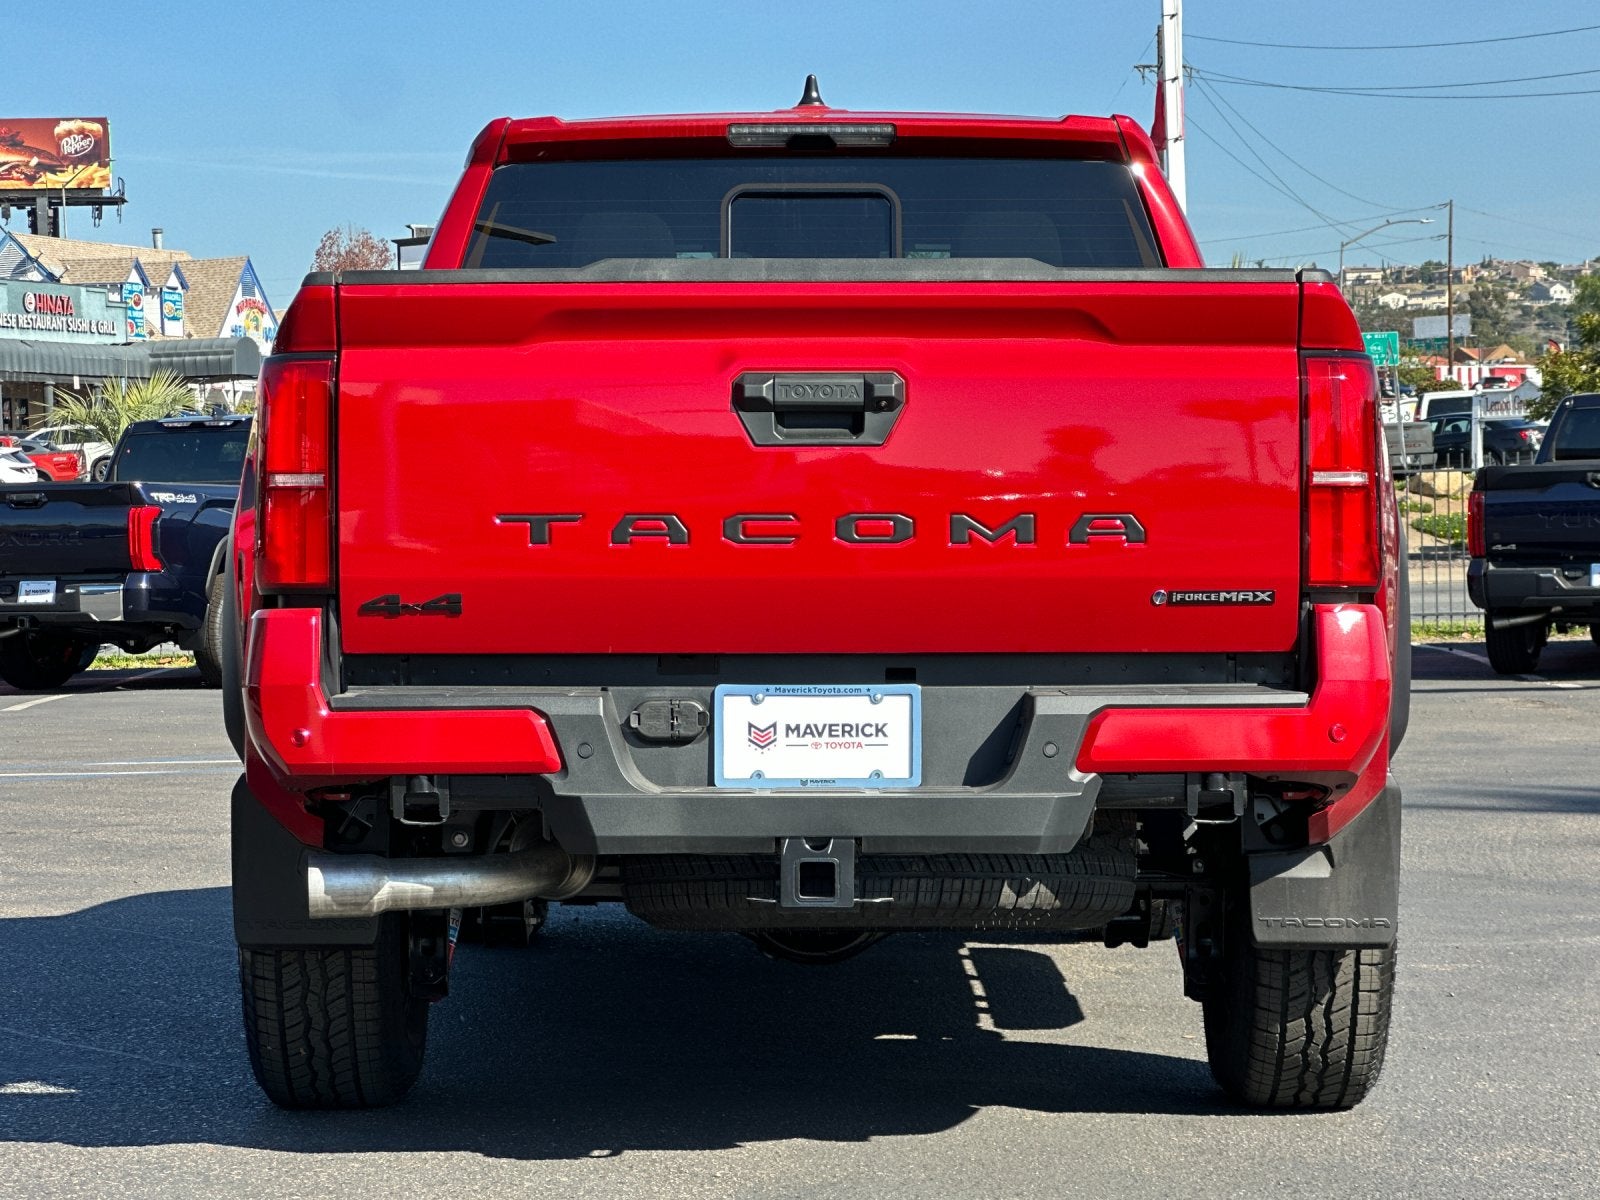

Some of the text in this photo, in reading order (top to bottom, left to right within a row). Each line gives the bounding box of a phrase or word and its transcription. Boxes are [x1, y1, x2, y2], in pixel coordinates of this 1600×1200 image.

[63, 137, 91, 154] Pepper
[70, 134, 83, 144] Dr
[35, 293, 75, 316] HINATA
[18, 313, 67, 332] RESTAURANT
[68, 317, 88, 334] SUSHI
[91, 319, 97, 335] &
[98, 320, 117, 336] GRILL
[778, 384, 861, 399] TOYOTA
[150, 493, 175, 503] TRD
[493, 512, 1148, 548] TACOMA
[774, 687, 862, 695] MaverickToyota.com
[785, 723, 889, 738] MAVERICK
[824, 742, 864, 750] TOYOTA
[1257, 917, 1391, 929] TACOMA
